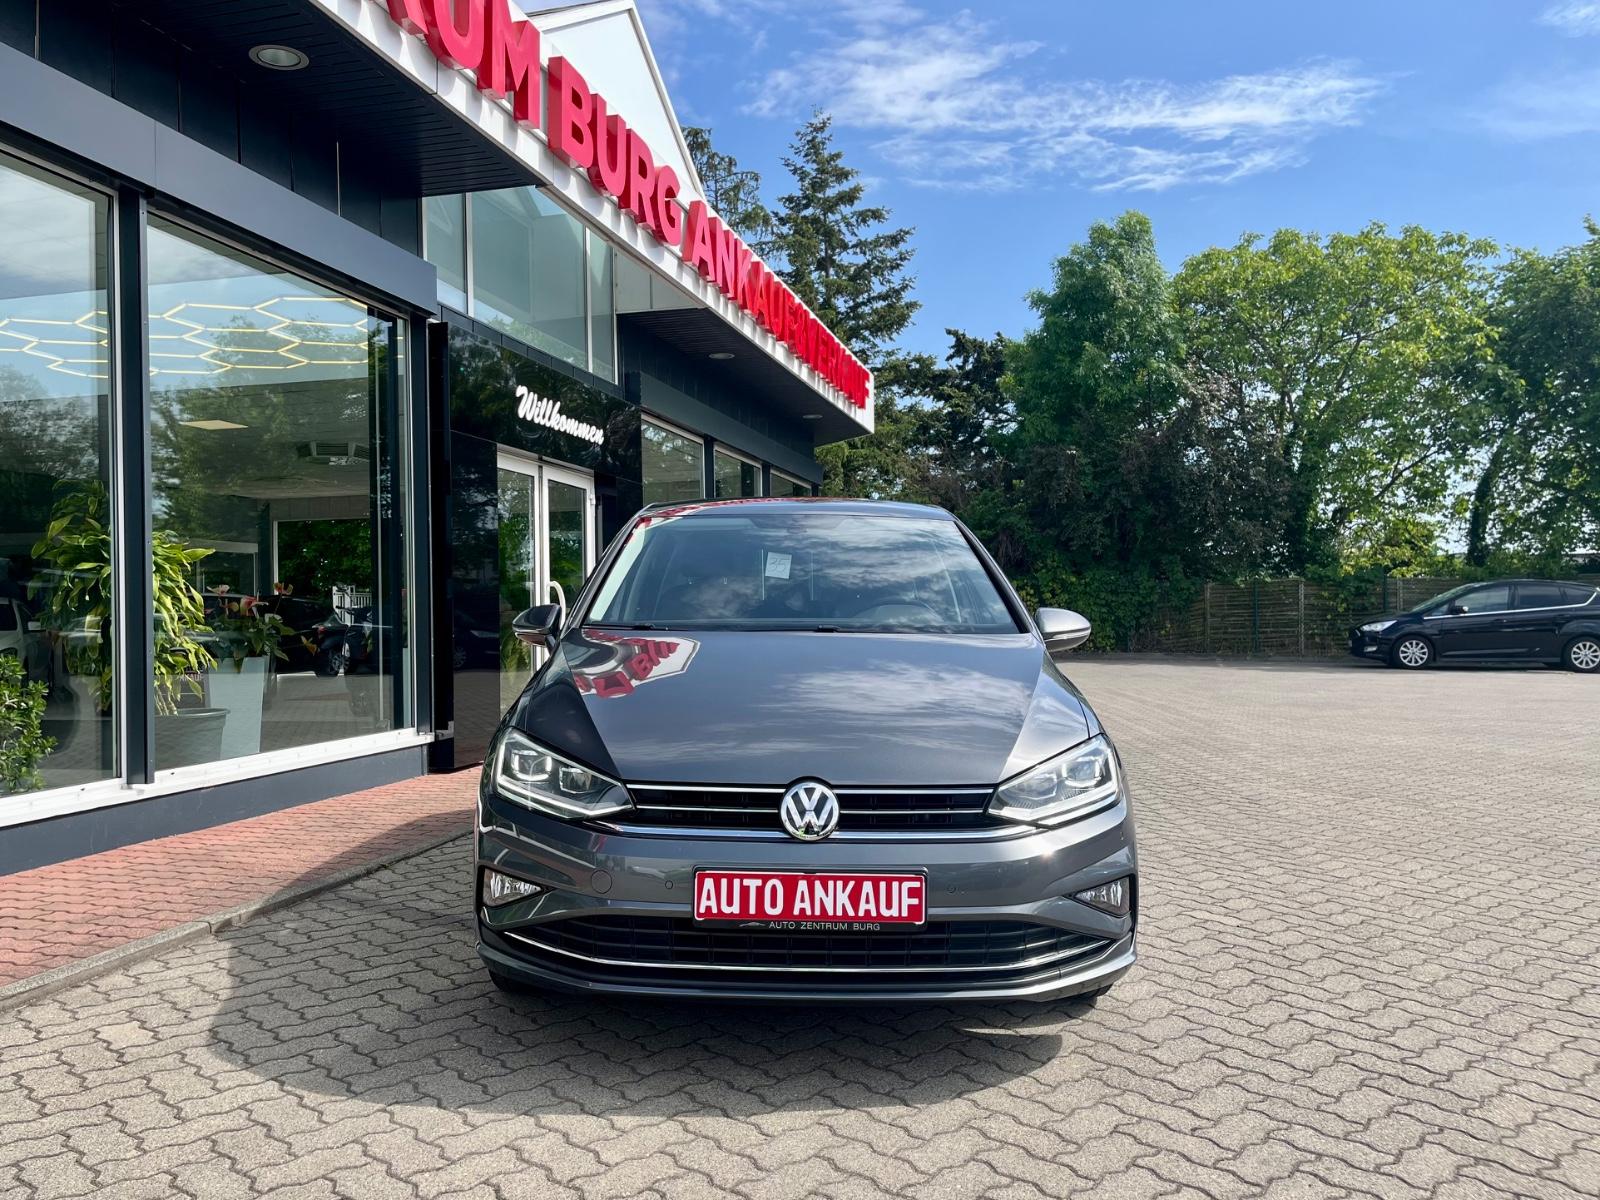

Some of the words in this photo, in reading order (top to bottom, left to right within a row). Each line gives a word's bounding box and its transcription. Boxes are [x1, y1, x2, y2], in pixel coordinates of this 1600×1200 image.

[388, 0, 541, 129] UM
[548, 56, 681, 246] BURG
[516, 385, 604, 445] Willkommen
[699, 877, 784, 916] AUTO
[793, 879, 921, 917] ANKAUF
[768, 921, 796, 929] AUTO
[800, 921, 848, 930] ZENTRUM
[853, 922, 881, 931] BURG
